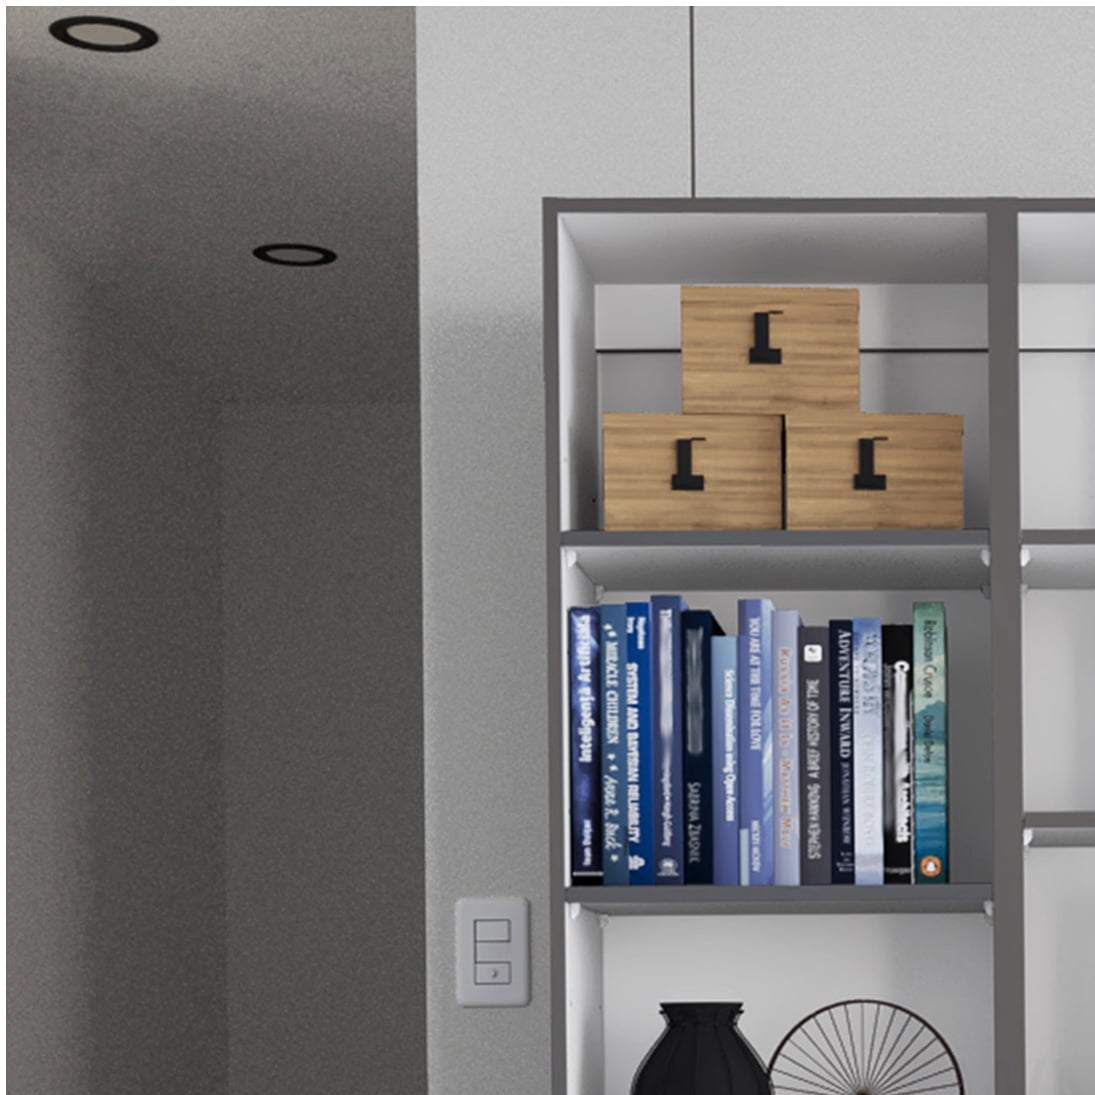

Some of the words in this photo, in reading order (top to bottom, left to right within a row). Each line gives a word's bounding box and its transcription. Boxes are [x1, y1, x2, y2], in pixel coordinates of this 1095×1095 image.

[750, 617, 762, 636] YOU
[924, 620, 939, 662] Robinson
[606, 641, 619, 687] MIRACLE
[751, 668, 762, 682] THE
[838, 630, 853, 703] ADVENTURE
[626, 662, 639, 704] SYSTEM
[724, 669, 736, 697] Science
[807, 679, 820, 698] TIME
[924, 665, 939, 699] Crusoe
[606, 690, 619, 744] CHILDREN
[626, 707, 639, 730] AND
[751, 709, 762, 727] FOR
[779, 698, 792, 717] As
[807, 700, 820, 710] OF
[751, 728, 762, 751] LOVE
[807, 711, 820, 746] HISTORY
[839, 707, 853, 758] INWARD
[923, 715, 935, 738] Daniel
[626, 732, 639, 781] BAYESIAN
[722, 753, 736, 773] using
[807, 748, 820, 771] BRIEF
[722, 774, 737, 795] Open
[627, 784, 640, 844] RELIABILITY
[688, 781, 702, 821] SABRINA
[725, 796, 737, 822] Access
[807, 783, 821, 820] HAWKING
[606, 823, 623, 852] Buck
[807, 822, 821, 859] STEPHEN
